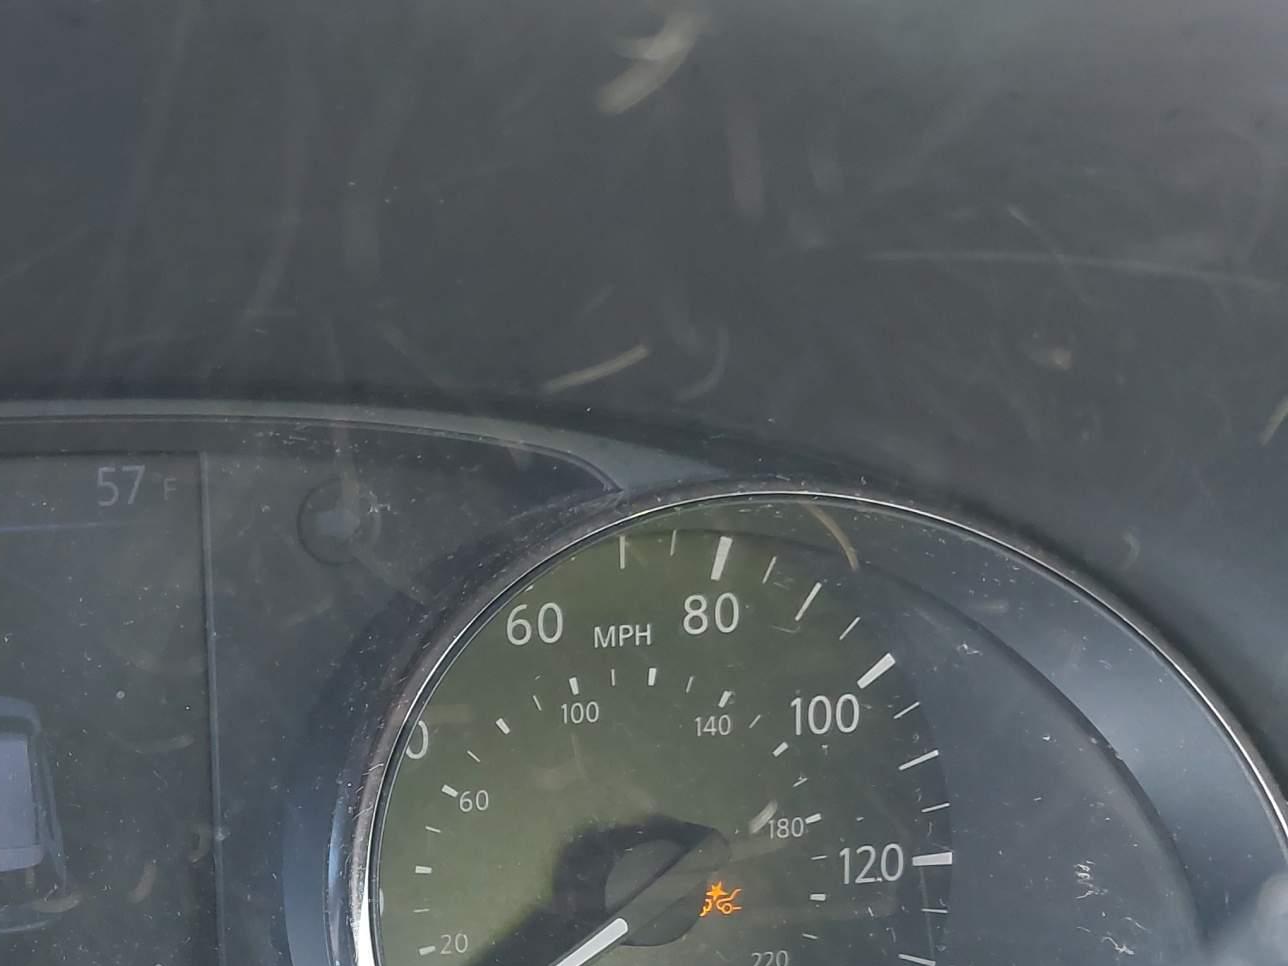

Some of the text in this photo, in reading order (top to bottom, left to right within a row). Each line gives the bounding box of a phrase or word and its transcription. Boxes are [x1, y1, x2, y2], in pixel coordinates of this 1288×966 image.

[96, 464, 146, 507] 57
[506, 602, 564, 645] 60
[683, 593, 740, 635] 80
[593, 623, 653, 649] MPH
[561, 702, 600, 725] 100
[695, 714, 732, 738] 140
[790, 694, 860, 736] 100
[458, 789, 490, 813] 60
[768, 816, 805, 840] 180
[839, 843, 905, 885] 120
[440, 933, 469, 955] 20
